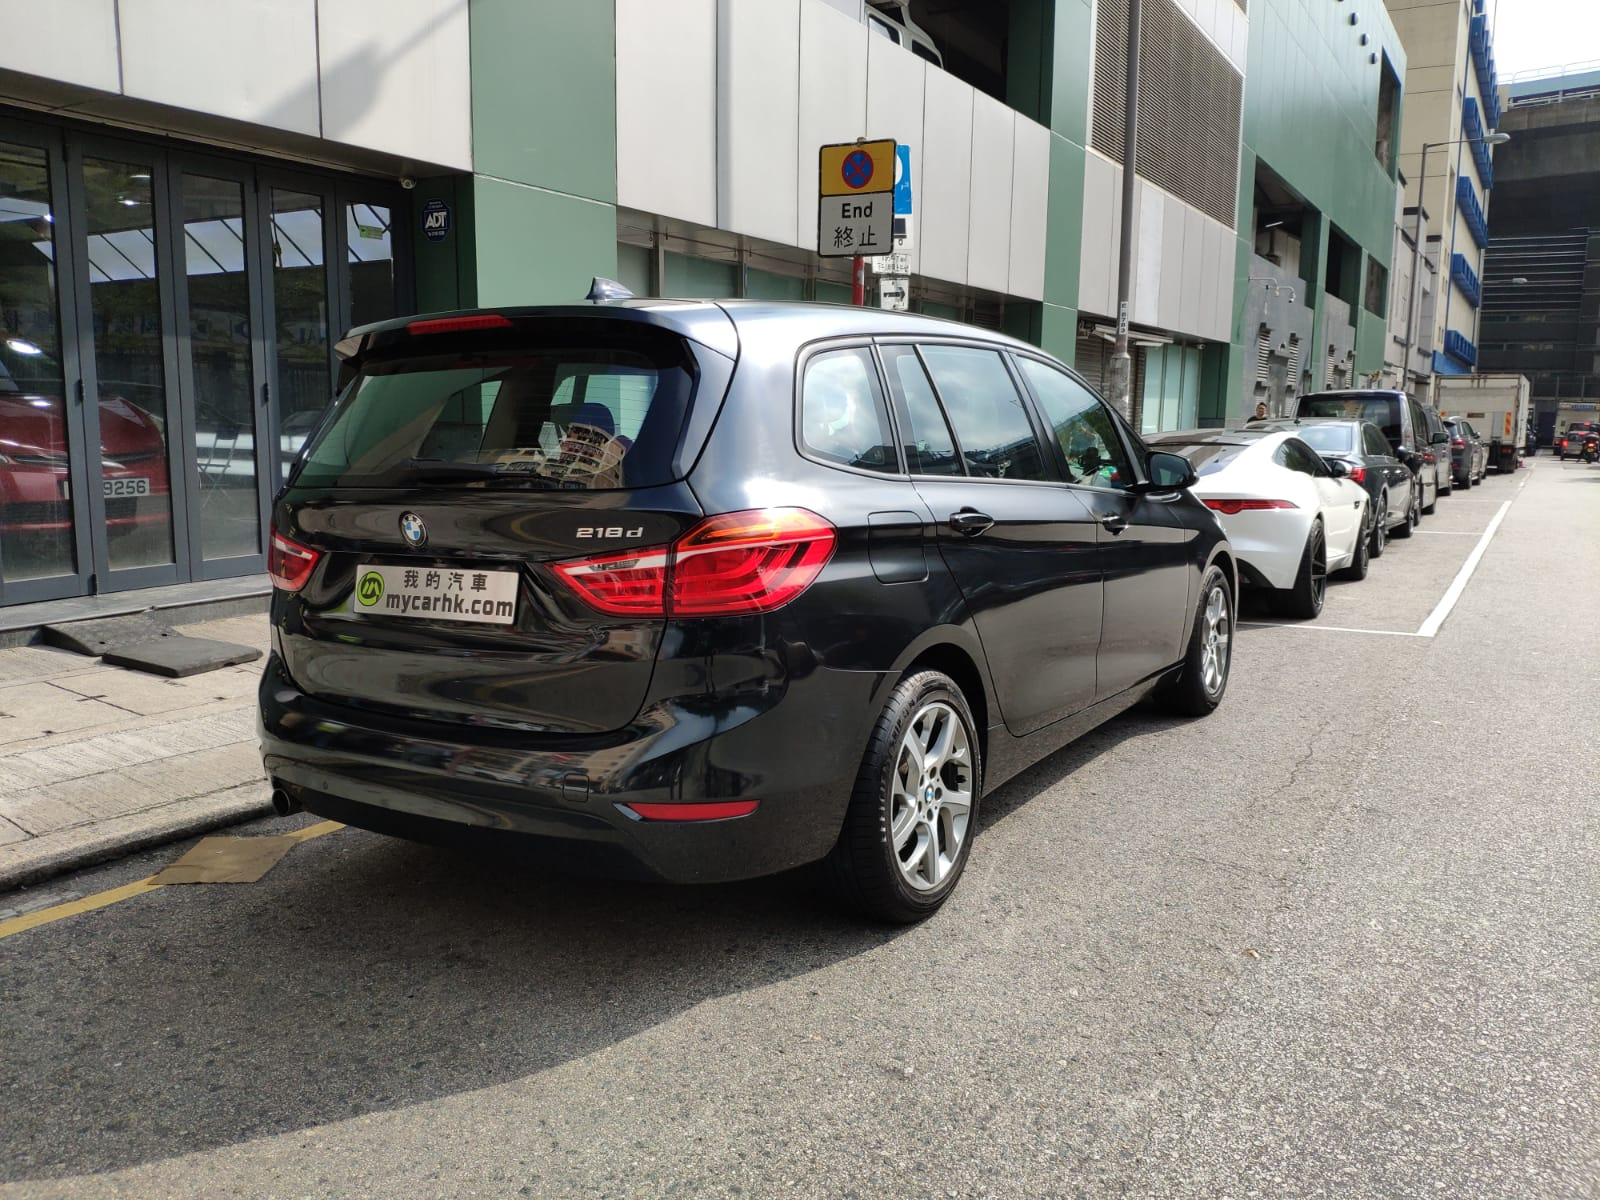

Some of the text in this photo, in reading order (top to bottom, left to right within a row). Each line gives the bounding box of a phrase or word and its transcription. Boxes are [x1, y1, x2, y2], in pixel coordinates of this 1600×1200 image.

[842, 202, 873, 219] End
[425, 211, 447, 229] ADT
[834, 225, 877, 248] 終止
[103, 480, 146, 496] 9256
[576, 526, 644, 539] 218d
[404, 569, 488, 593] 我的汽車
[385, 593, 514, 618] mycarhk.com
